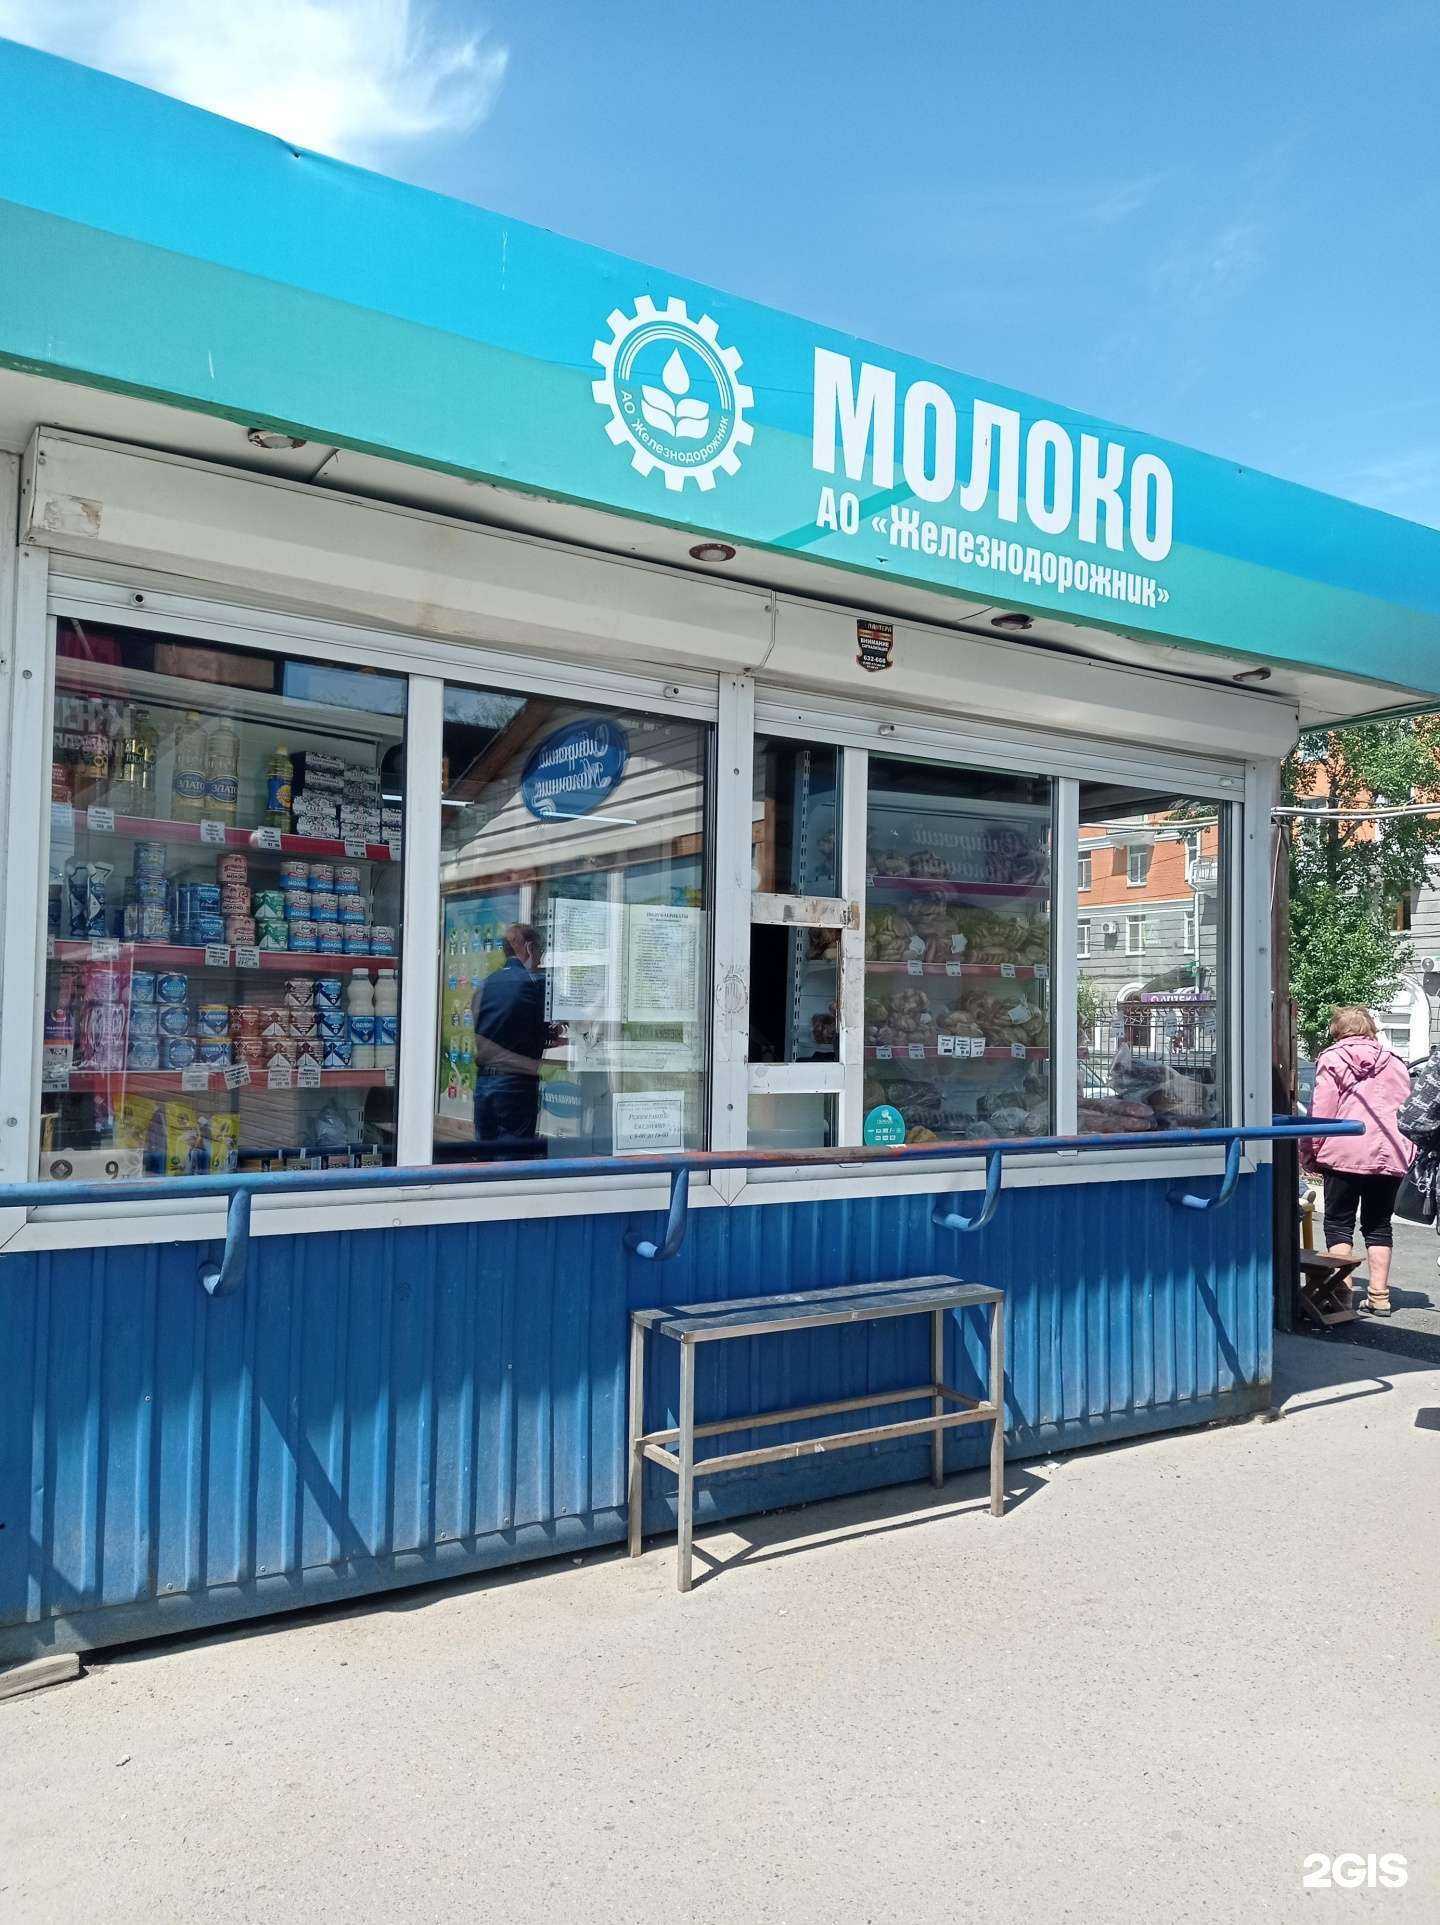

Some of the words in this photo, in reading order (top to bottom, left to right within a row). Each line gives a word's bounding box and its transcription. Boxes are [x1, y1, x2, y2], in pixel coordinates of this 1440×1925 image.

[621, 390, 636, 414] АО
[631, 416, 729, 464] Железнодорожник
[812, 346, 1173, 562] МОЛОКО
[816, 486, 860, 535] АО
[871, 504, 1170, 608] «Железнодорожник»
